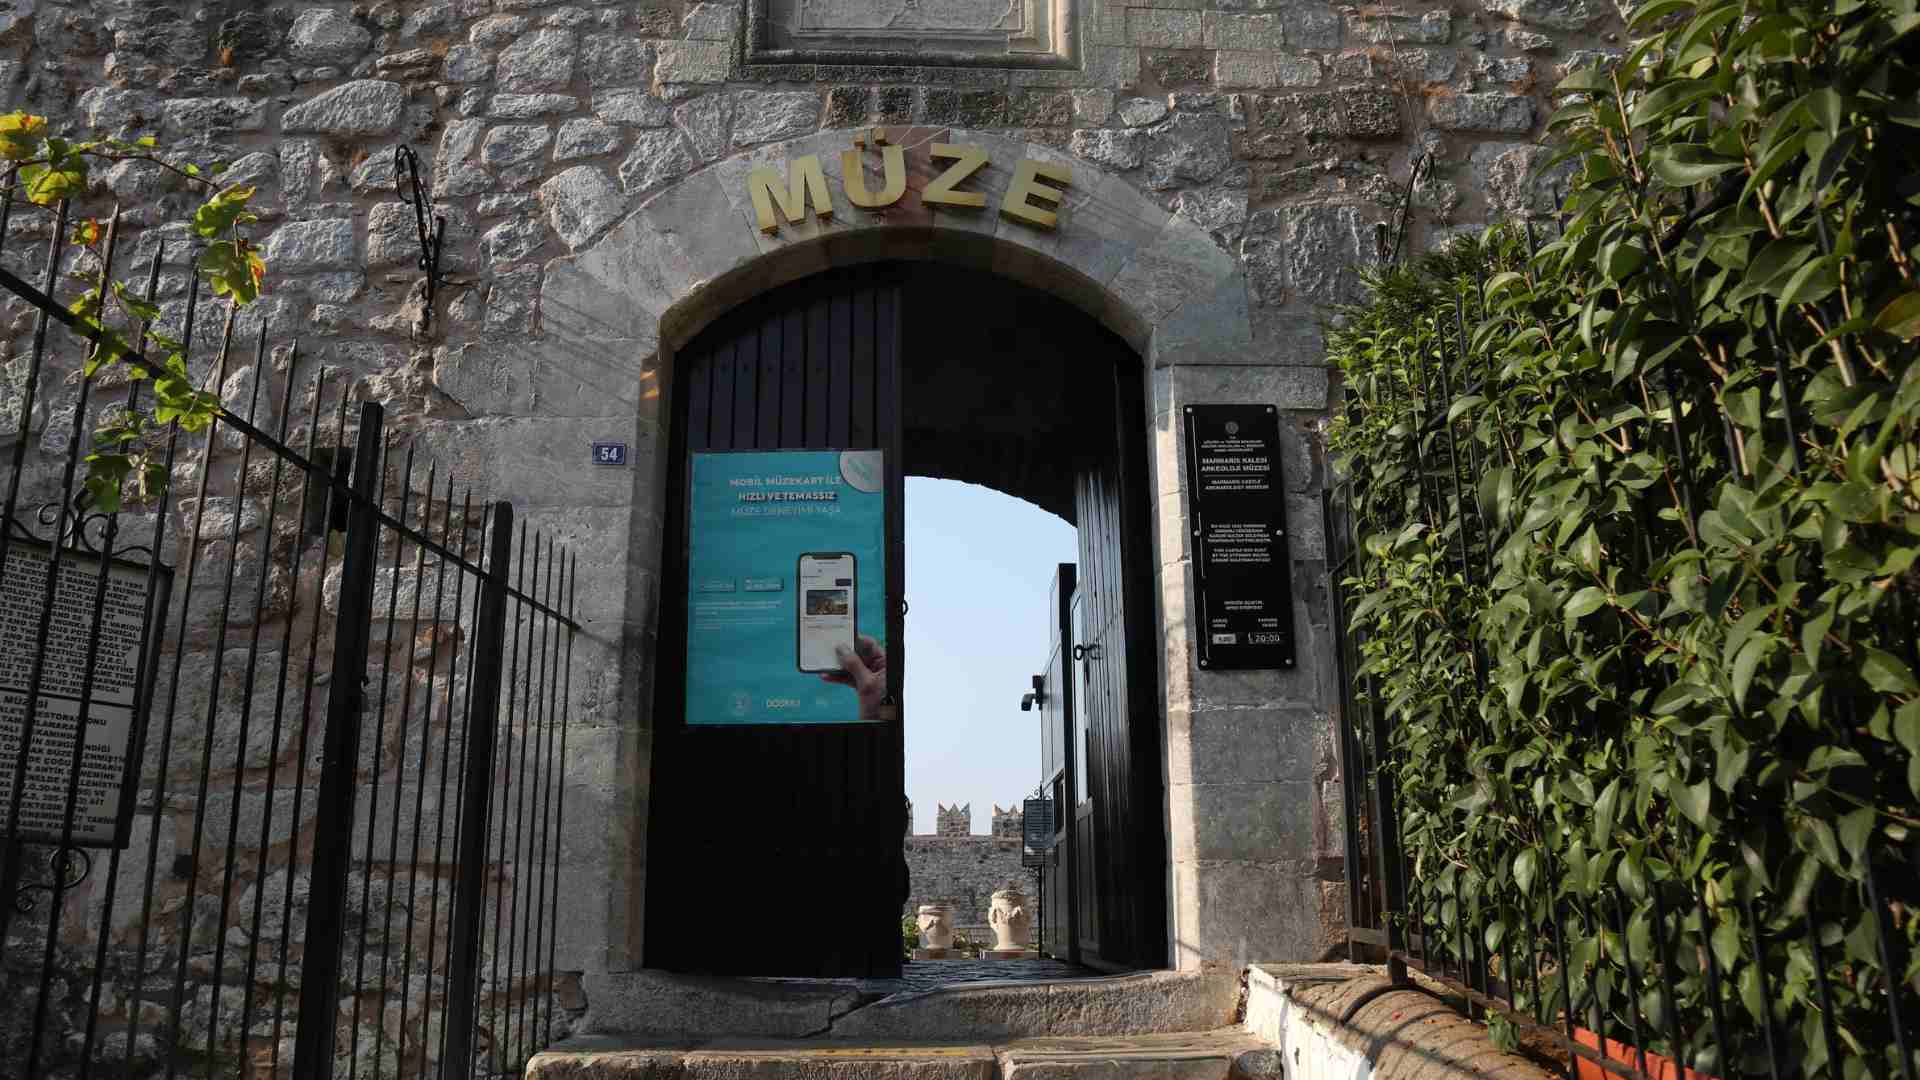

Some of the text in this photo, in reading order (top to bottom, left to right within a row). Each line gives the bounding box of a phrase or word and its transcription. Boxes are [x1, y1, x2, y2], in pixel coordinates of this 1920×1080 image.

[746, 128, 1073, 233] MÜZE
[600, 447, 619, 461] 54
[3, 693, 48, 708] MÜZSİ
